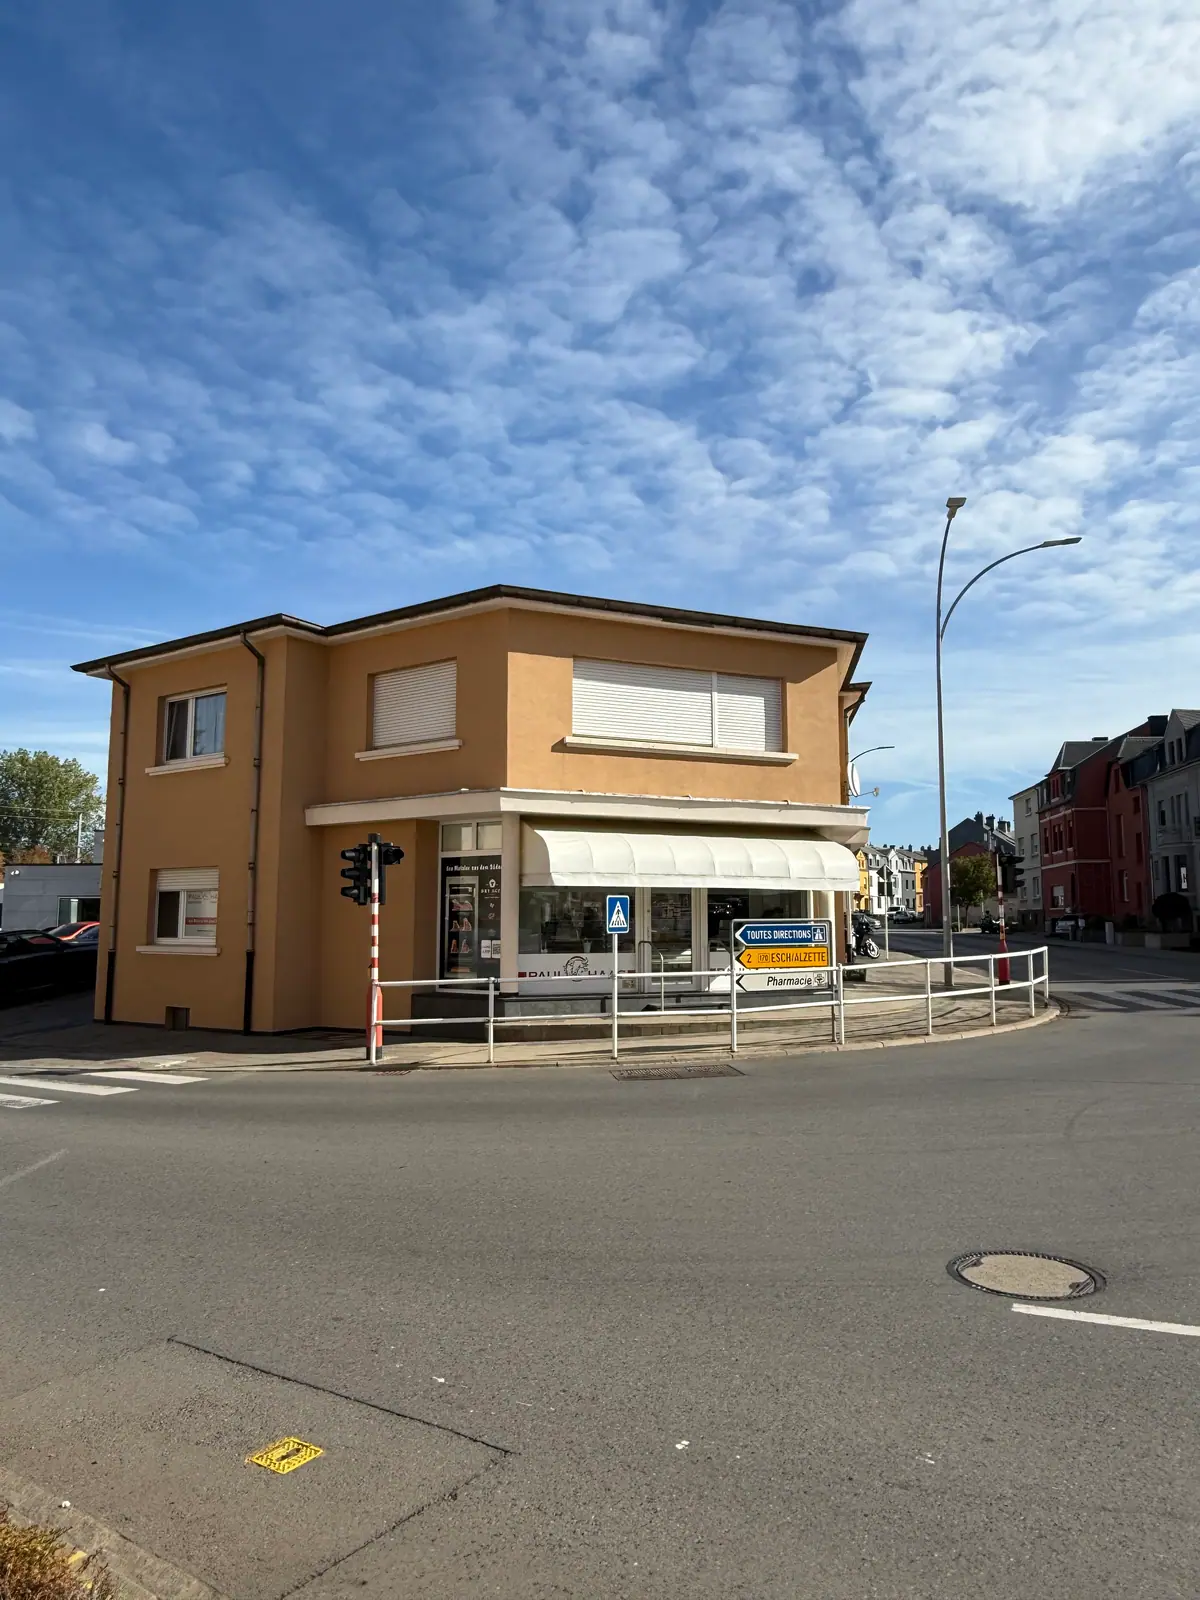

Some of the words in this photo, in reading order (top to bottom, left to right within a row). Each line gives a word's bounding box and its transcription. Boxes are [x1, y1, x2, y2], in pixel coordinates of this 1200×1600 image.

[746, 930, 772, 940] TOUTES
[773, 929, 811, 939] DIRECTIONS
[746, 953, 752, 964] 2
[771, 951, 826, 963] ESCH/ALZETTE
[766, 976, 813, 987] Pharmacie
